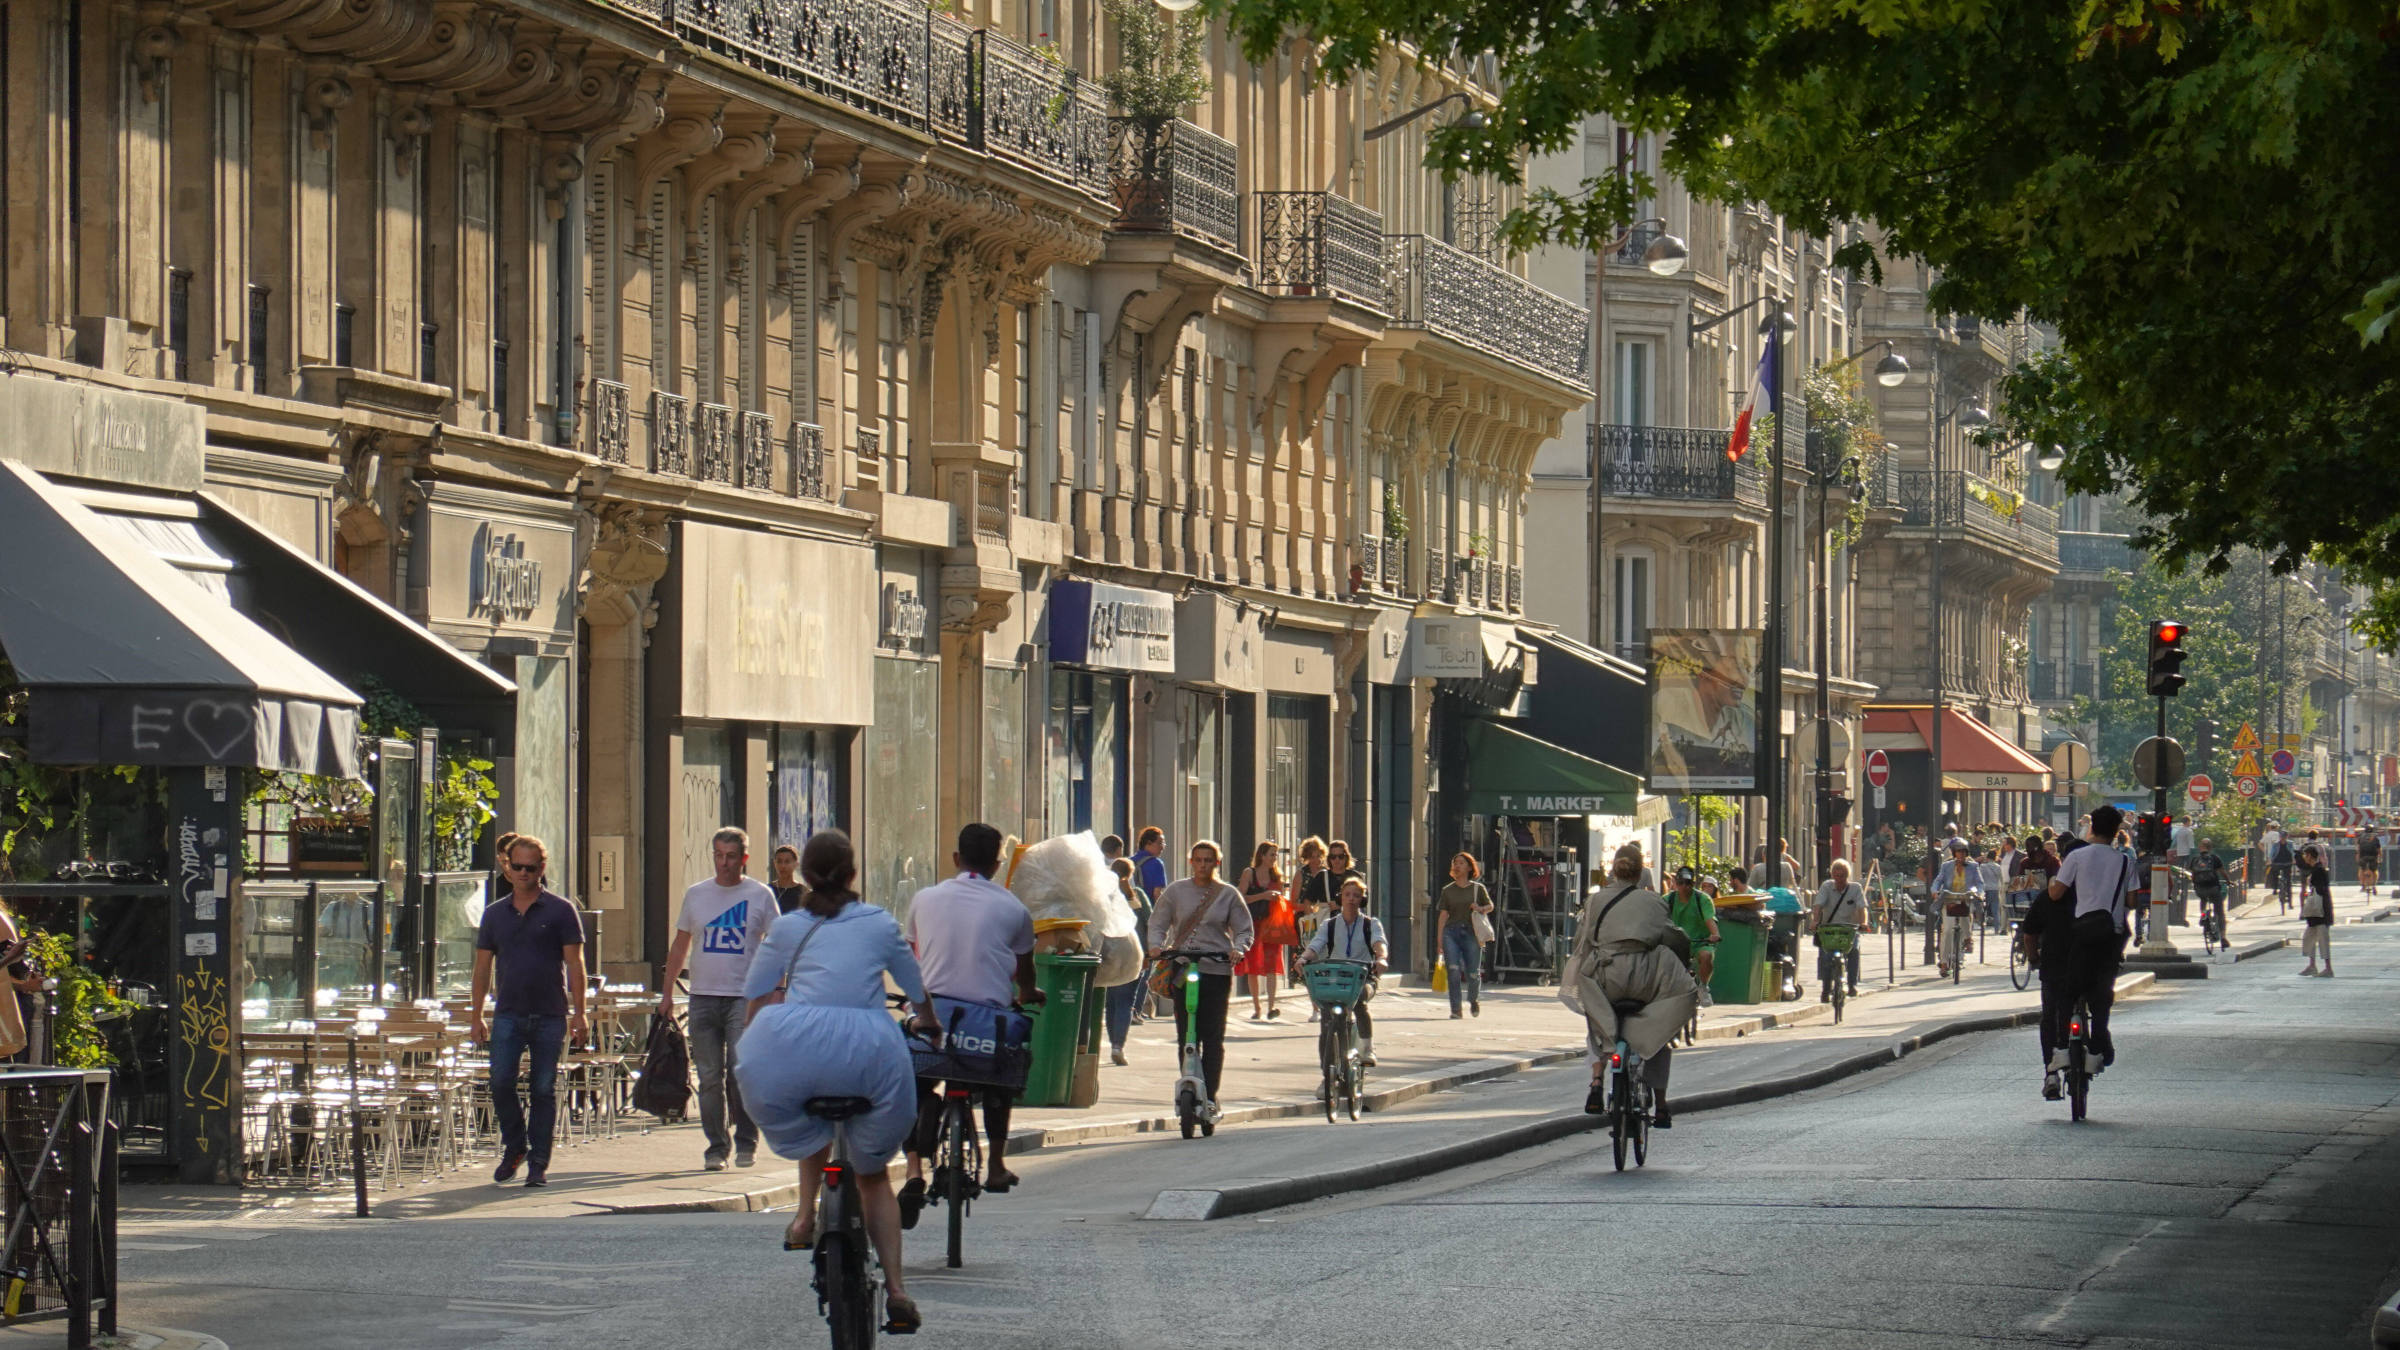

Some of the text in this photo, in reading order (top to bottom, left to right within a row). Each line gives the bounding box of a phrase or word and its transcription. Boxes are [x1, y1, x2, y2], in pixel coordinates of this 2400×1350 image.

[1437, 647, 1475, 663] Tech
[1986, 776, 2008, 786] BAR
[2242, 782, 2253, 791] 30
[1500, 796, 1604, 810] T. MARKET
